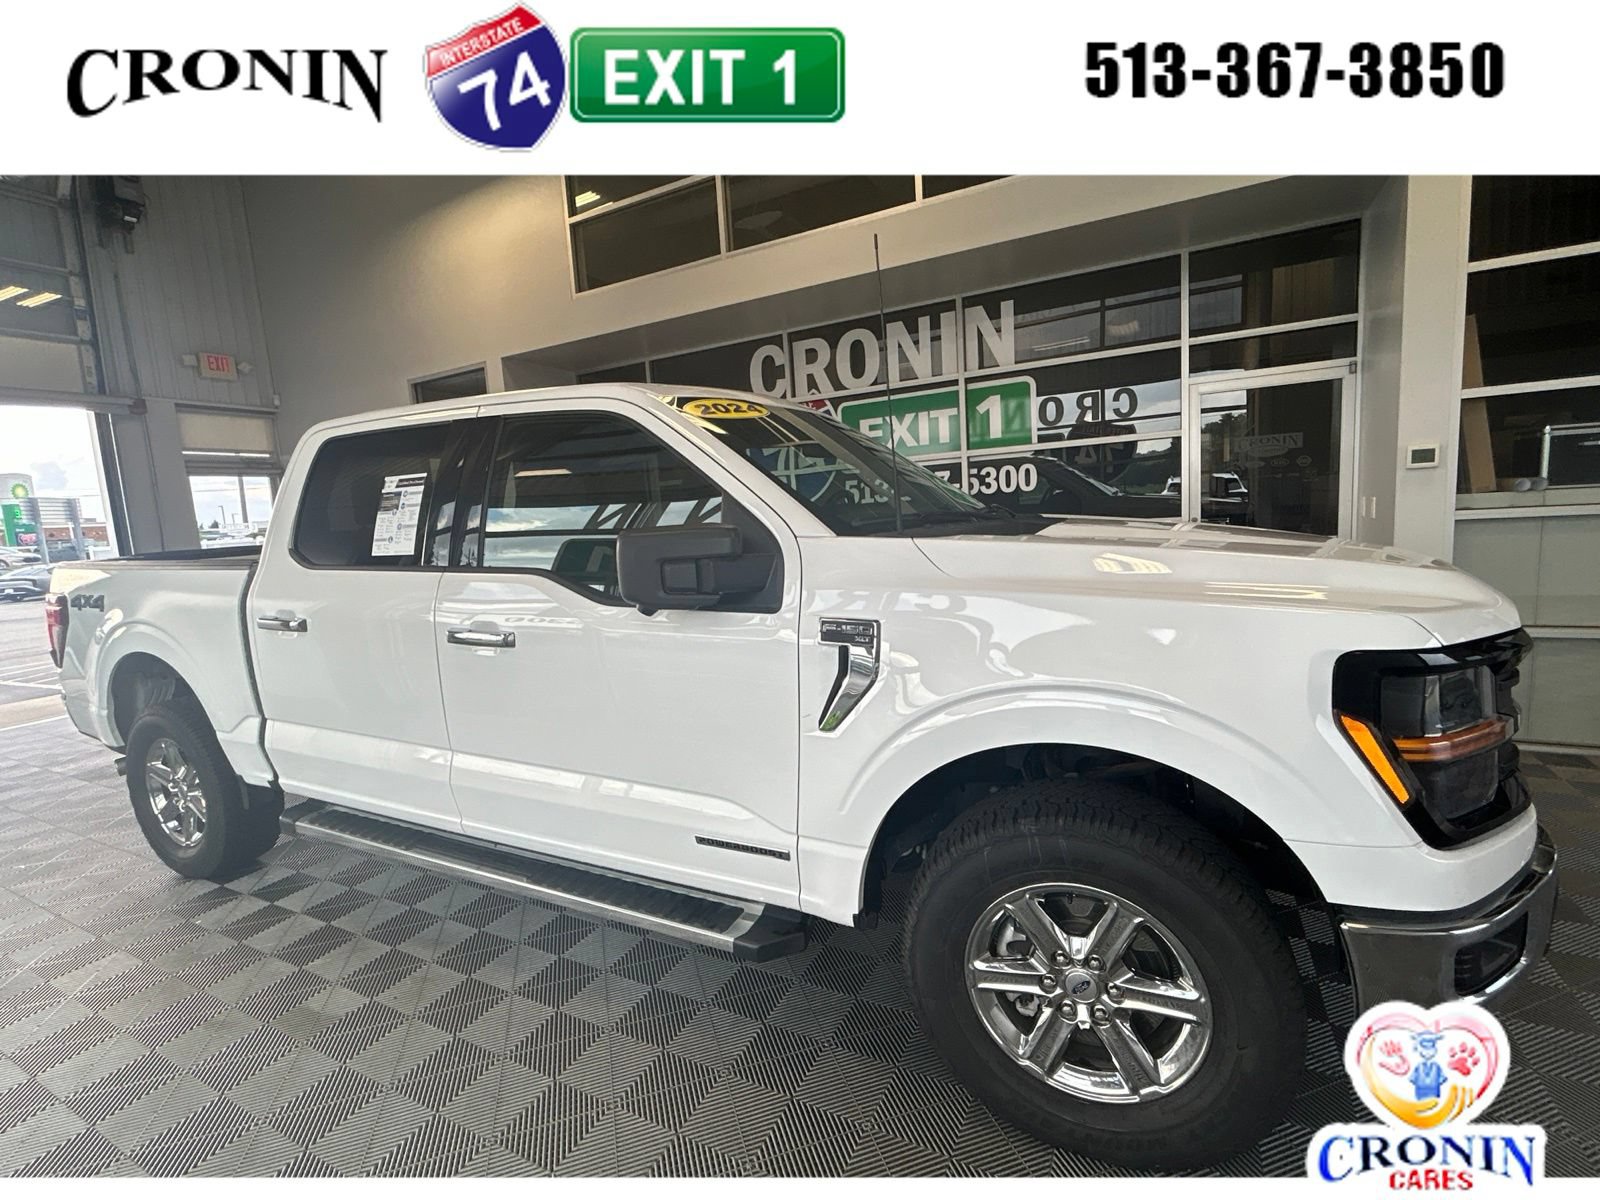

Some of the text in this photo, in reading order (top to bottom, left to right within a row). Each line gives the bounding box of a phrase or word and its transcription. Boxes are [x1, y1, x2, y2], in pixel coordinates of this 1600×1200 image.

[749, 299, 1016, 400] CRONIN
[694, 402, 763, 416] 2024
[859, 394, 1002, 449] EXIT 1
[822, 623, 873, 636] F-150
